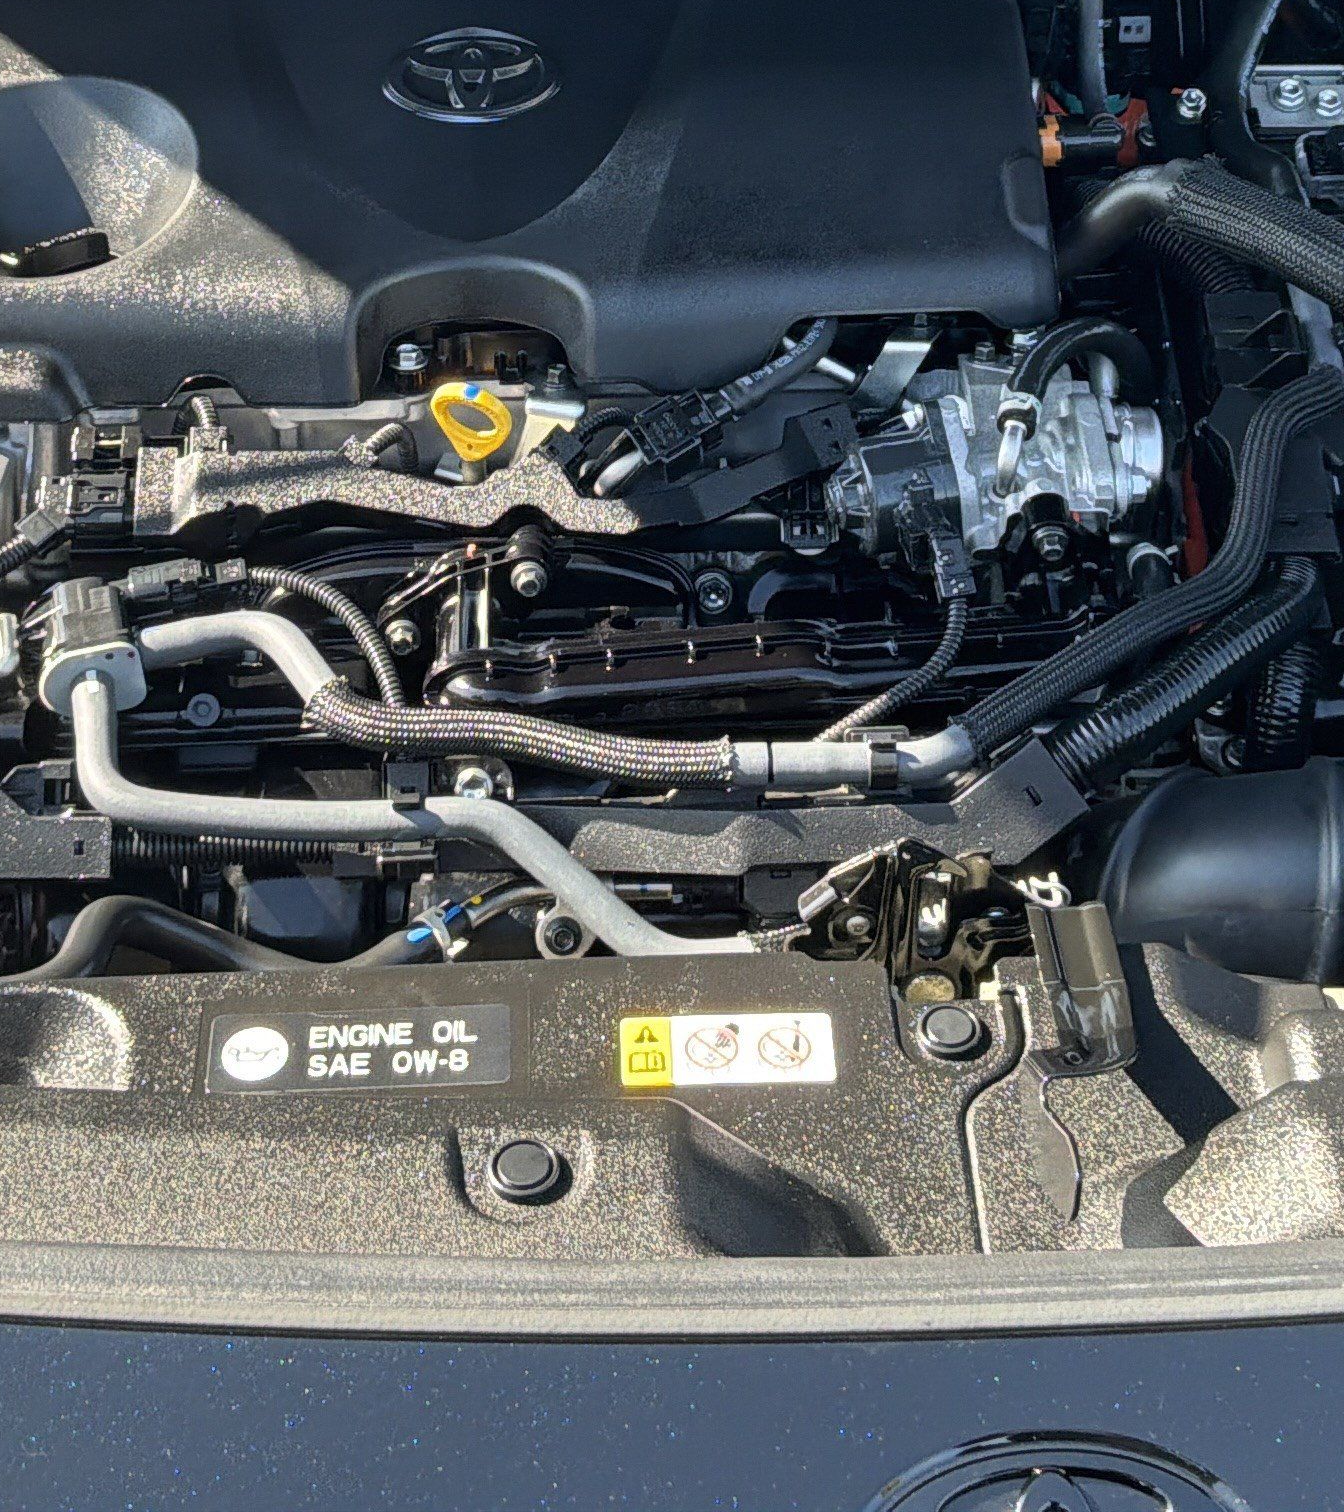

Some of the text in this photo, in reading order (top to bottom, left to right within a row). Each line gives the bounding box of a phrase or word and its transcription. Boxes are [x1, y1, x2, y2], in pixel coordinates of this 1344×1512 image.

[308, 1020, 479, 1049] ENGINE OIL
[307, 1052, 372, 1078] SAE
